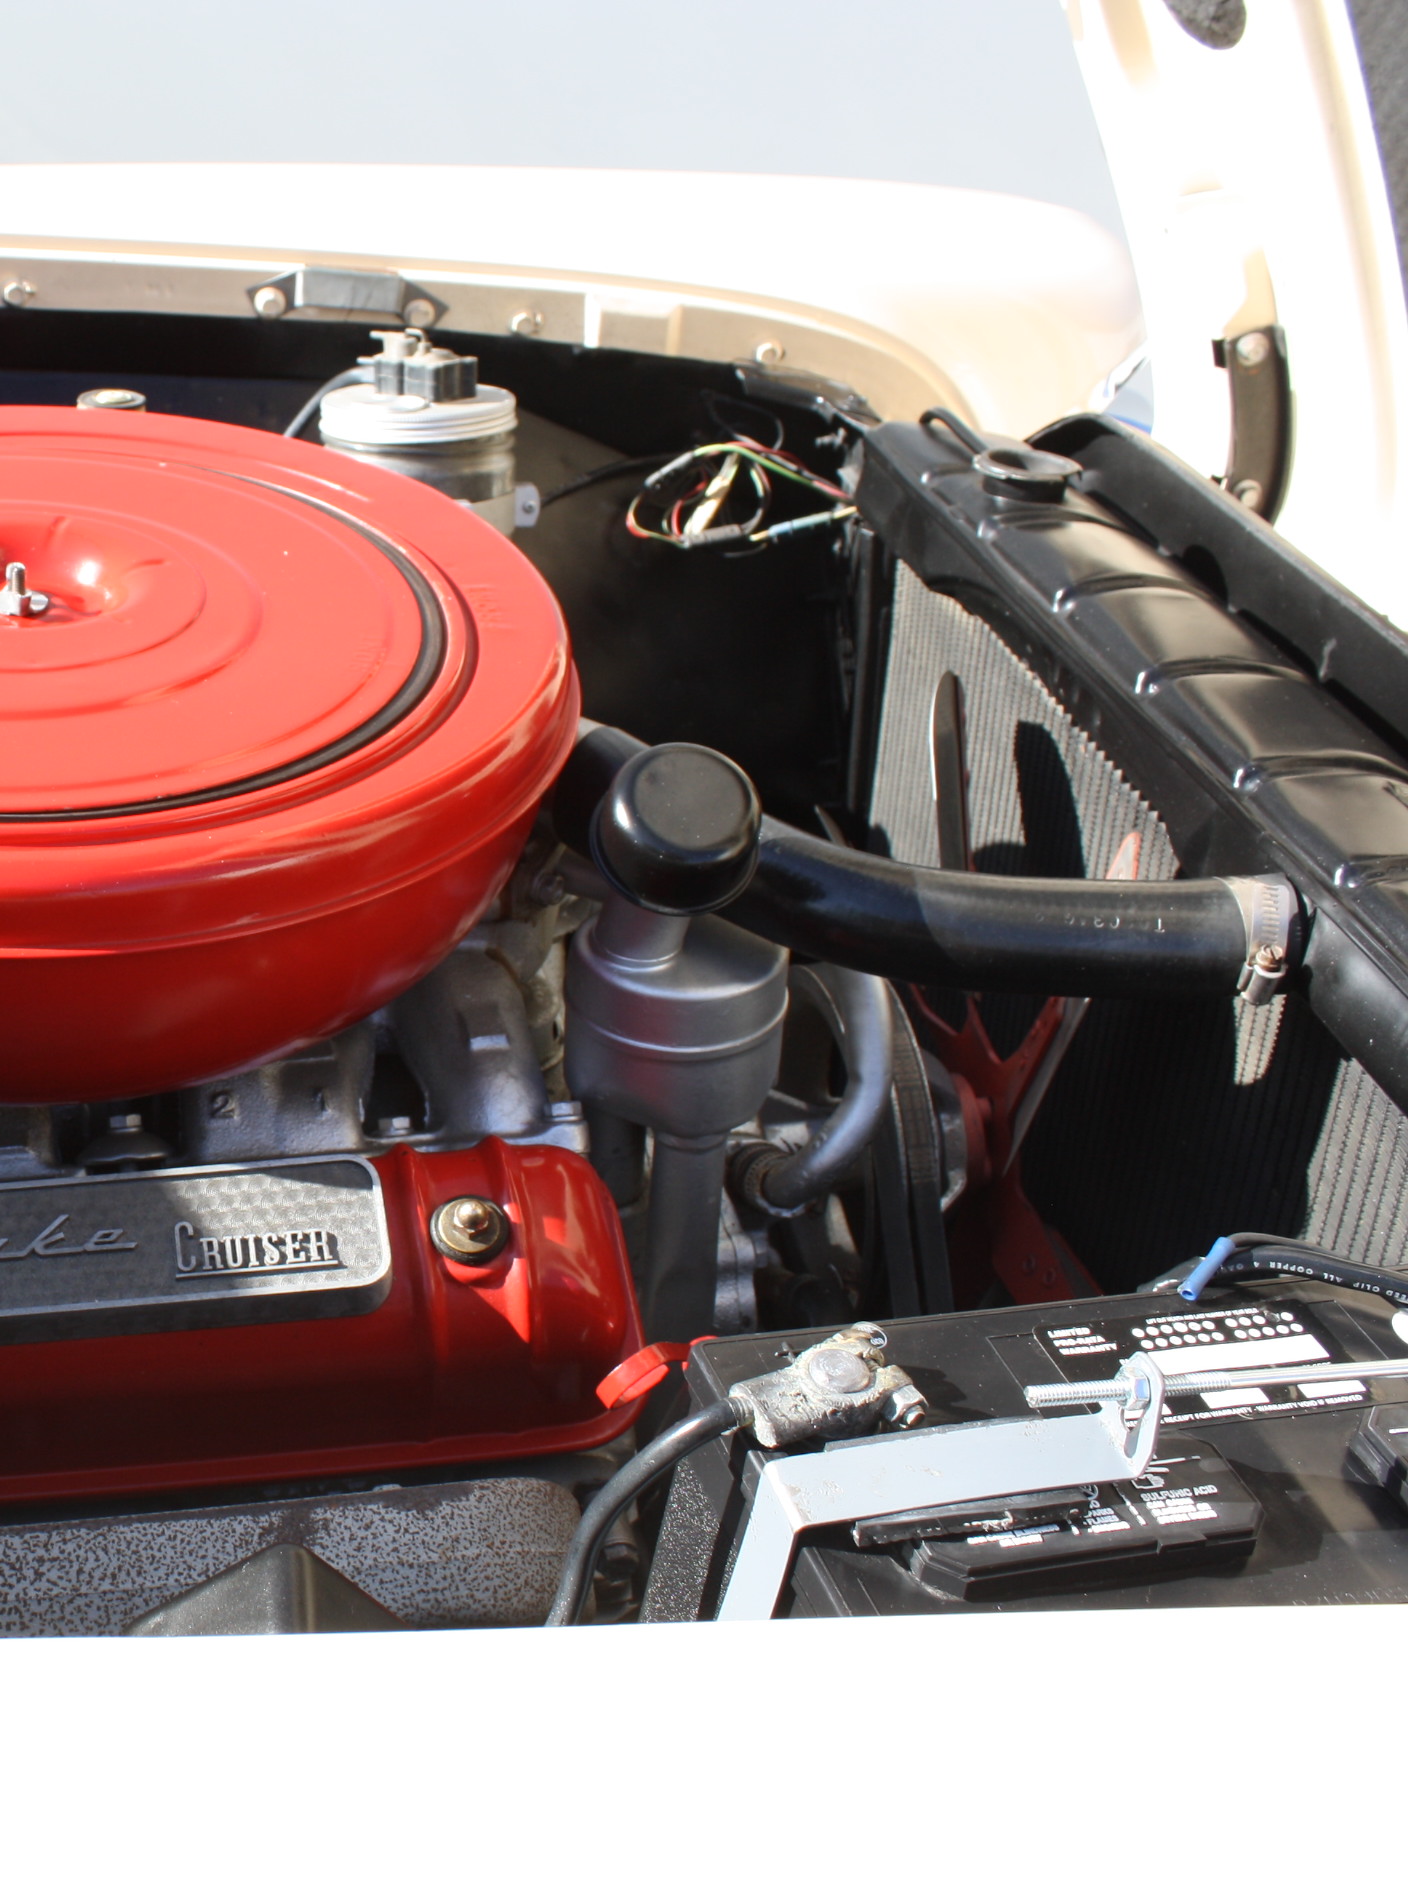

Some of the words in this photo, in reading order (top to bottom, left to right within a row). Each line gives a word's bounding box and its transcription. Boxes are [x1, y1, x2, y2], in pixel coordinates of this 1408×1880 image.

[1269, 1261, 1314, 1275] COPPER
[1322, 1272, 1342, 1283] ALL
[1385, 1289, 1408, 1301] EED
[1195, 1410, 1212, 1420] FOR
[1212, 1406, 1253, 1418] WARRANTY
[1256, 1401, 1298, 1413] WARRANTY
[1298, 1399, 1318, 1408] VOID
[1327, 1394, 1363, 1405] REMOVED
[1193, 1484, 1218, 1496] ACID
